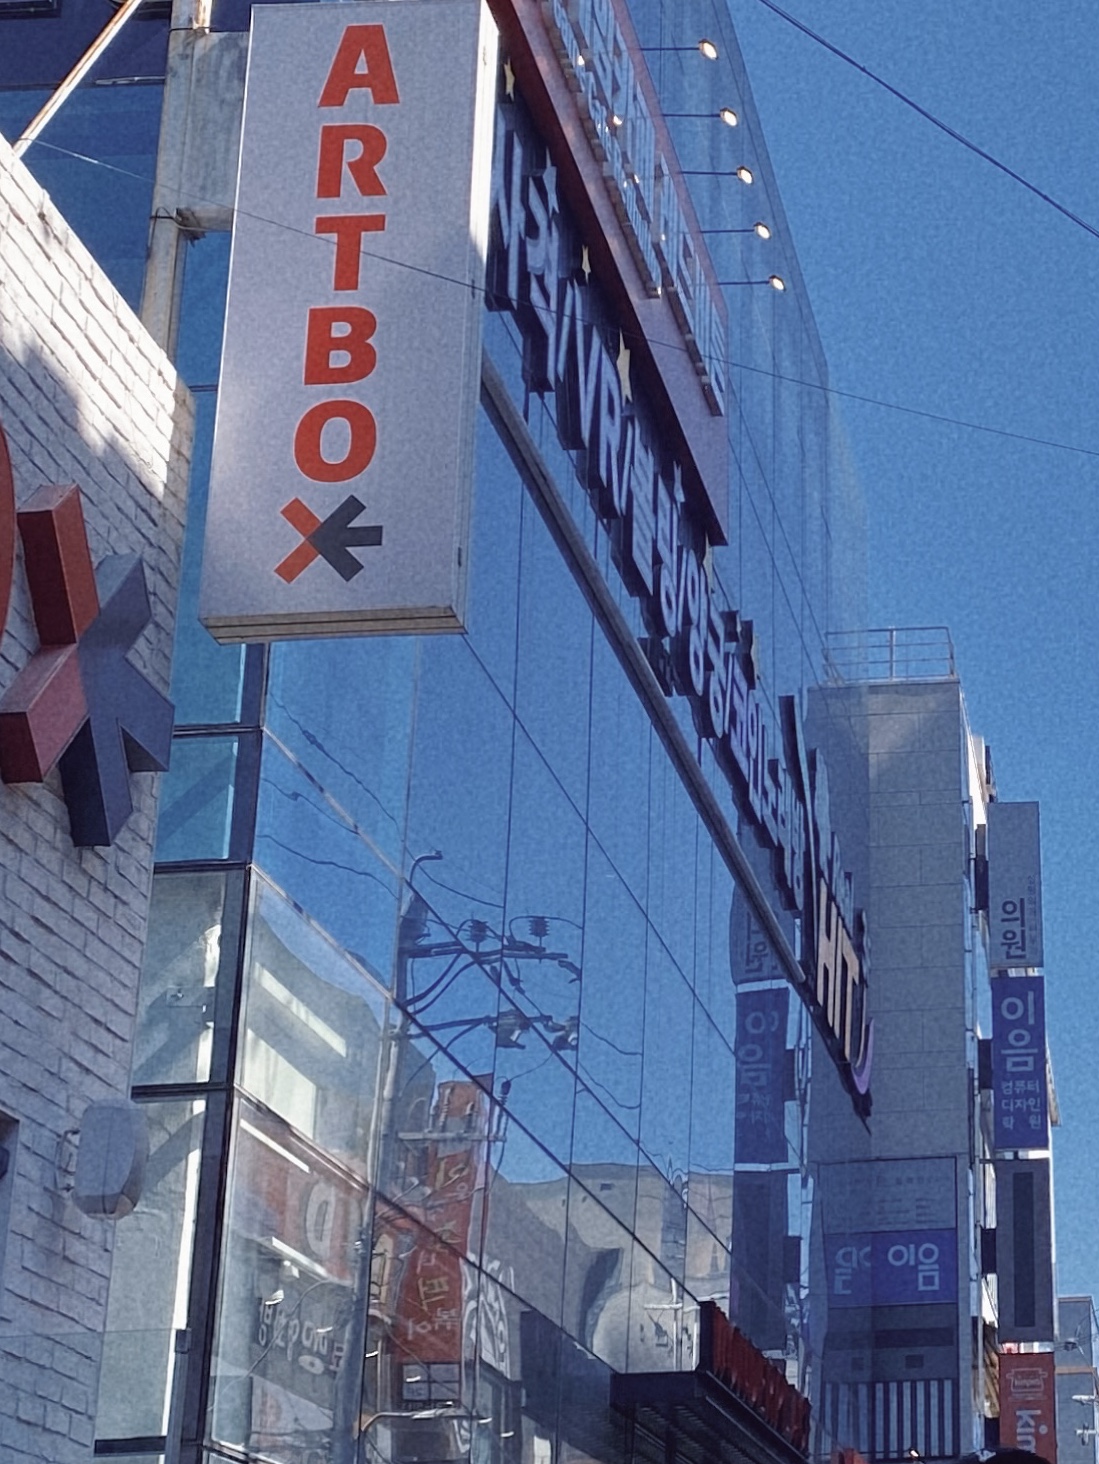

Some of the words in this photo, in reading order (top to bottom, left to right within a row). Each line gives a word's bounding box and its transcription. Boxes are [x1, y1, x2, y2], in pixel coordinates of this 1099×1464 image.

[273, 23, 401, 584] ARTBOX
[1000, 897, 1027, 961] 의원
[1000, 990, 1040, 1074] 이음
[1001, 1078, 1041, 1096] 컴퓨터
[1001, 1096, 1042, 1114] 디자인
[887, 1242, 940, 1292] 이음
